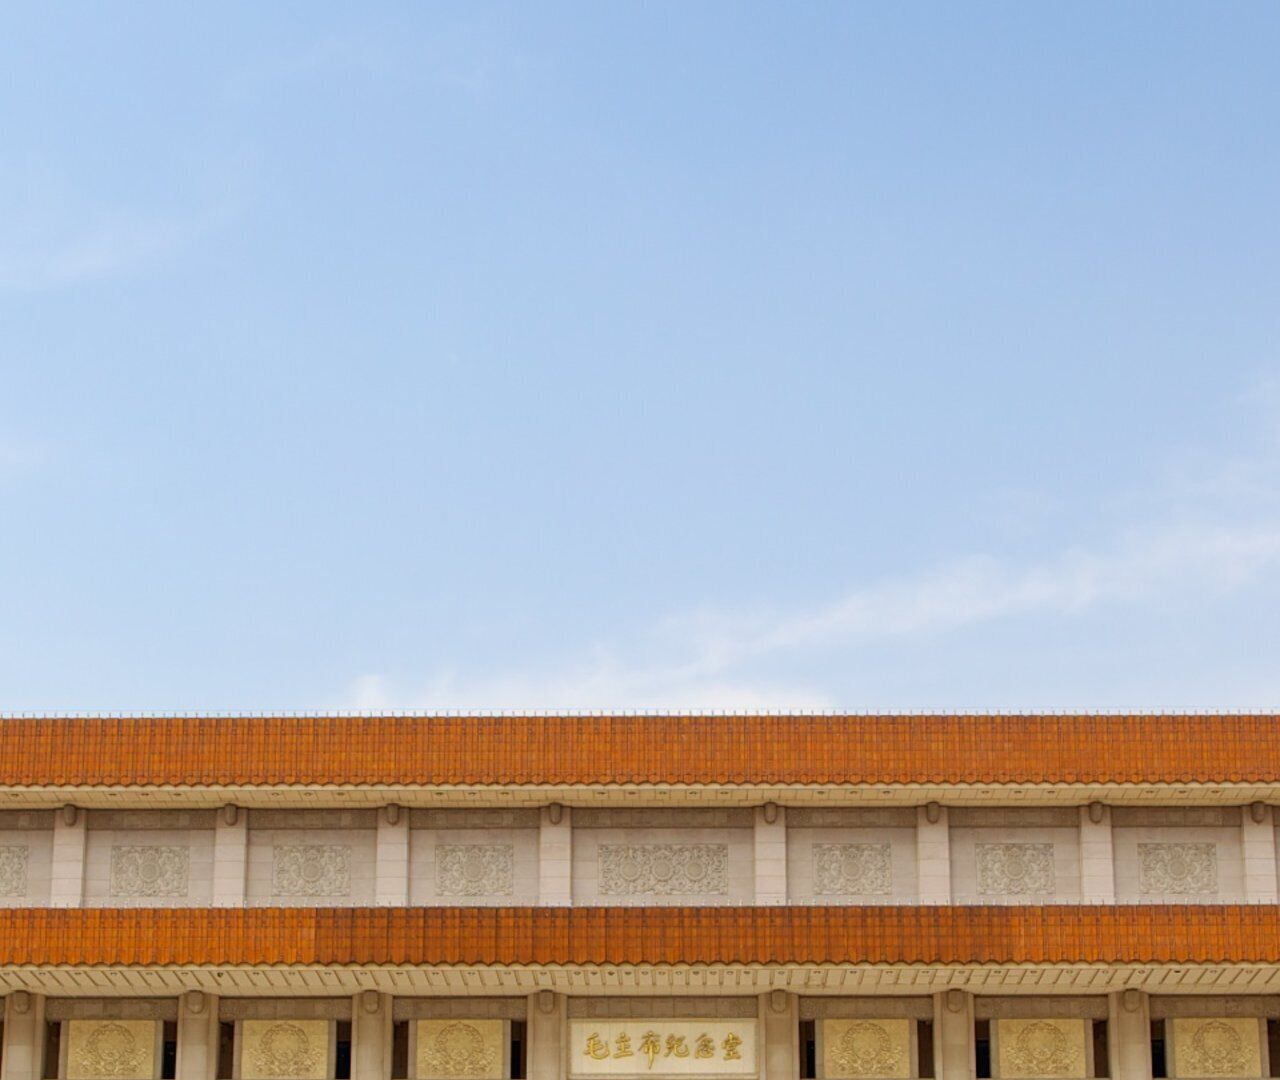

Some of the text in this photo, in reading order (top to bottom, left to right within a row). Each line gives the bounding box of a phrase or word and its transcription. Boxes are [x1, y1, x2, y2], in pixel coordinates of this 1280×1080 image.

[583, 1030, 743, 1070] 毛主席纪念堂
